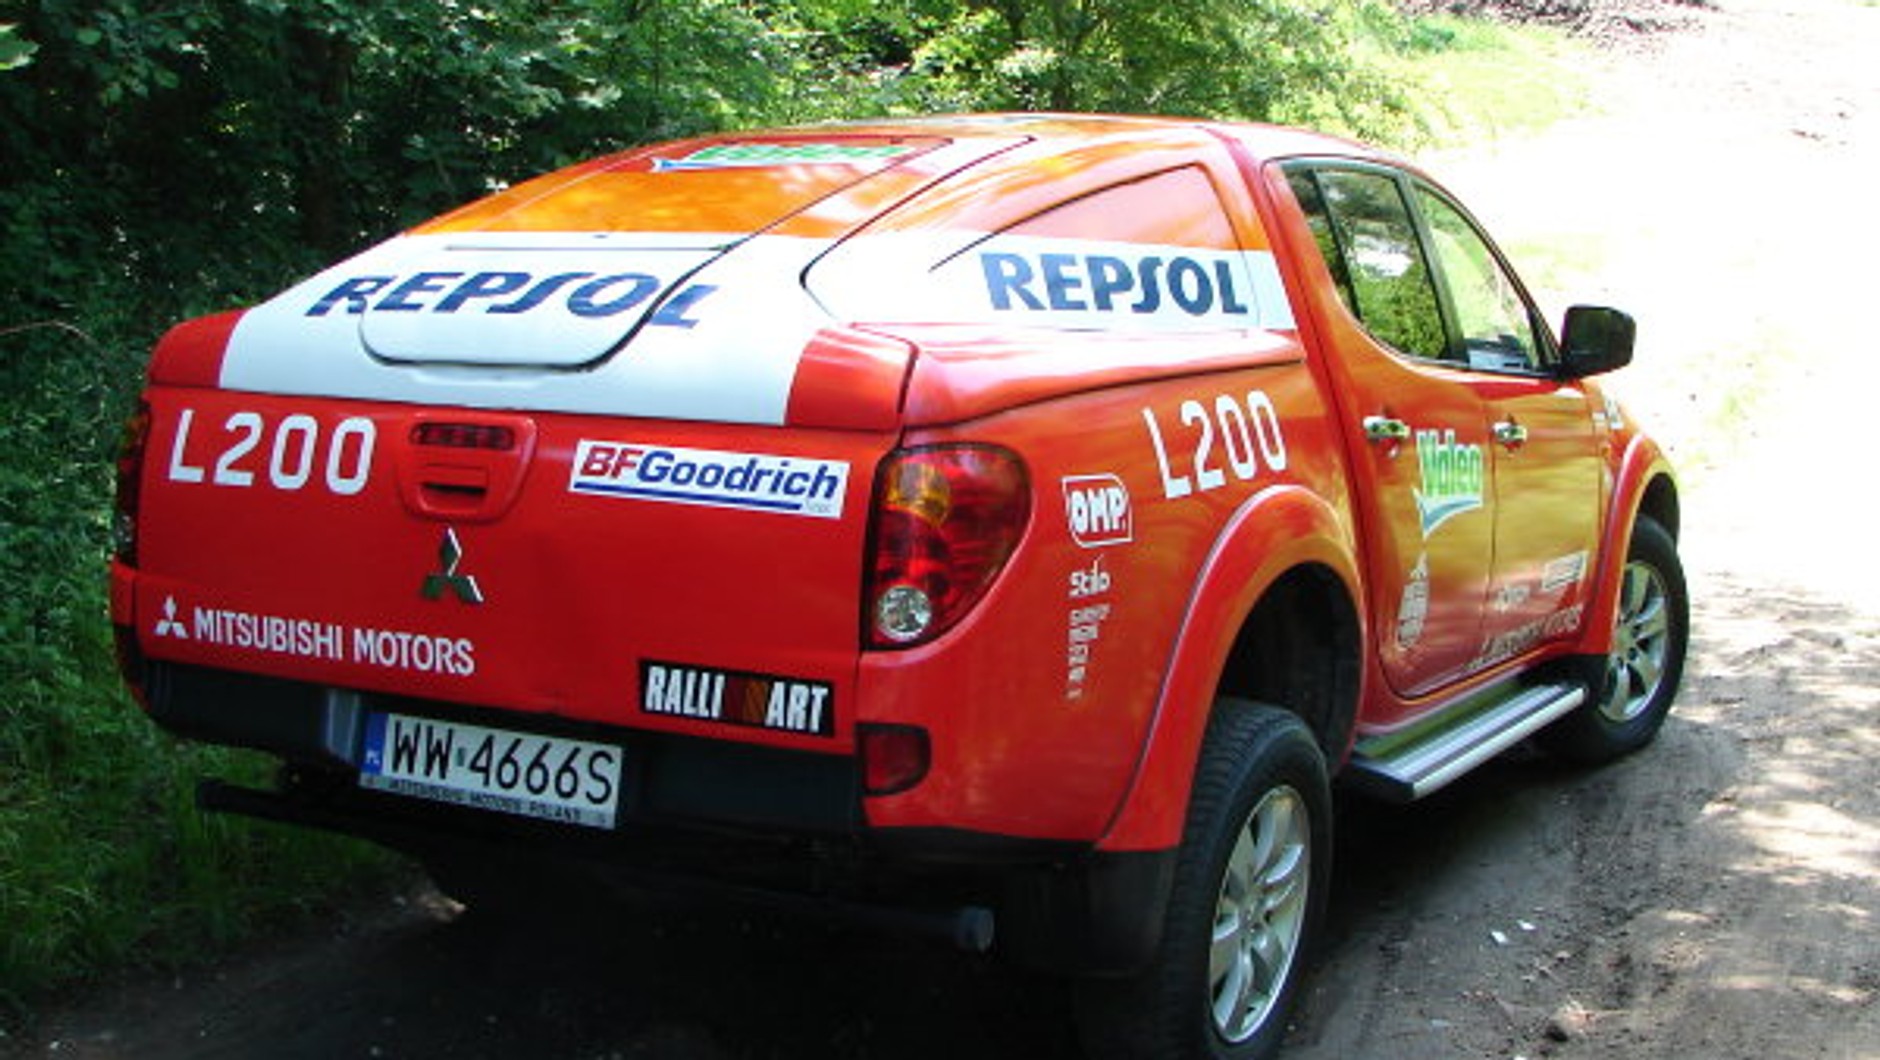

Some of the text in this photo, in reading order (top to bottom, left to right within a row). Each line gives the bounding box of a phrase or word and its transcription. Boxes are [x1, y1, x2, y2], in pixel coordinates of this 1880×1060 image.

[305, 271, 718, 329] REPSOL
[980, 252, 1248, 316] REPSOL
[168, 408, 377, 496] L200
[579, 444, 838, 499] BFGoodrich
[1142, 390, 1288, 499] L200
[1070, 487, 1126, 534] OMP
[194, 607, 476, 677] MITSUBISHI MOTORS
